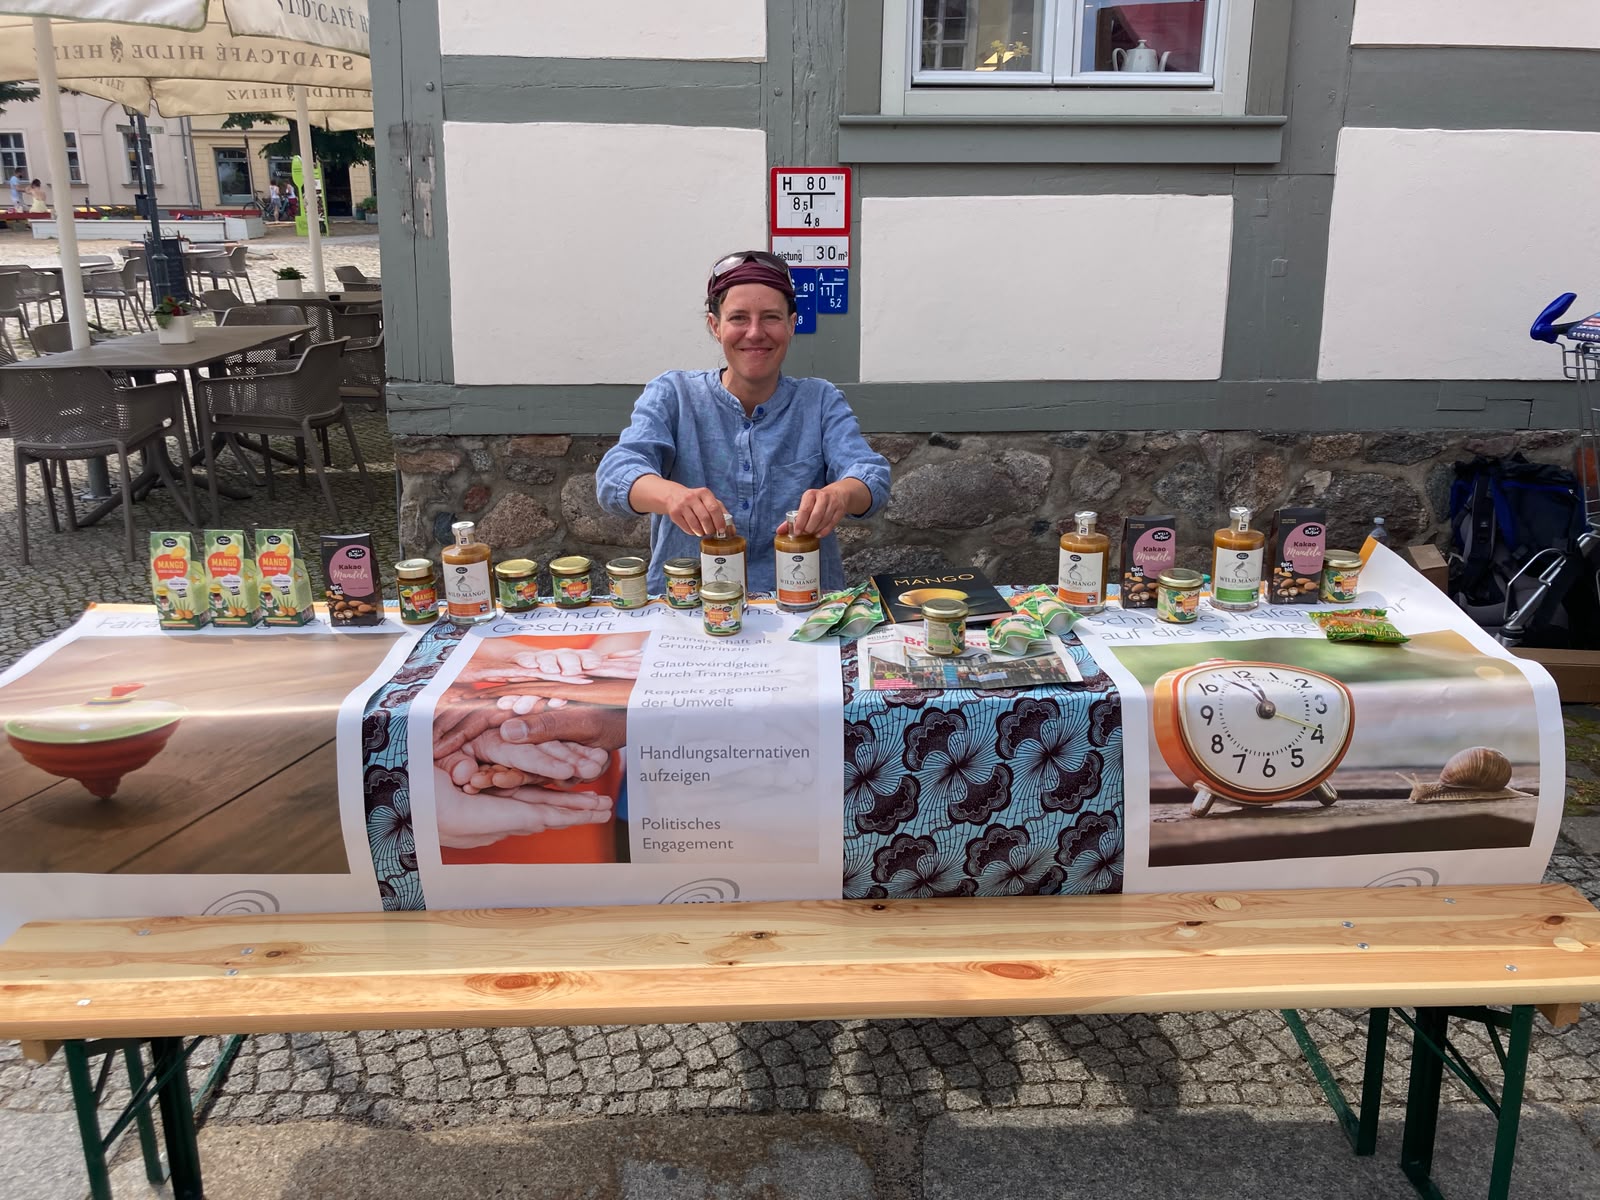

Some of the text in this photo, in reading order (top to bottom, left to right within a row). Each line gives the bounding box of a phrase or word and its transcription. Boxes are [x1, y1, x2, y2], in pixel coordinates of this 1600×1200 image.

[782, 176, 827, 191] H 80
[816, 246, 836, 260] 30
[818, 272, 825, 282] A
[803, 282, 815, 292] 80
[830, 298, 842, 309] 5,2
[1135, 550, 1171, 563] Mandeln
[1285, 546, 1322, 558] Mandeln
[157, 560, 184, 570] MANGO
[211, 558, 238, 568] MANGO
[262, 556, 288, 567] MANGO
[332, 568, 369, 581] Mandeln
[796, 577, 818, 585] MANGO
[894, 573, 975, 586] MANGO
[462, 589, 486, 598] MANGO
[492, 620, 617, 634] Geschäft
[1101, 627, 1140, 640] auf
[1152, 626, 1195, 638] die
[1201, 622, 1320, 638] Sprünge
[660, 634, 773, 646] Partnerschaft als
[658, 642, 751, 653] Grundprinzip
[652, 660, 770, 670] Glaubwürdigkeit
[649, 668, 782, 679] durch Transparenz
[1232, 669, 1255, 680] 12
[1198, 681, 1219, 697] 10
[1294, 678, 1313, 689] 2
[644, 685, 788, 696] Respekt gegenüber
[641, 697, 734, 709] der Umwelt
[1314, 694, 1328, 715] 3
[1199, 704, 1215, 727] 9
[1310, 723, 1325, 745] 4
[1210, 733, 1225, 755] 8
[639, 744, 811, 763] Handlungsalternativen
[1290, 747, 1305, 769] 5
[1232, 753, 1247, 774] 7
[1262, 757, 1277, 778] 6
[639, 768, 711, 785] aufzeigen
[641, 817, 721, 831] Politisches
[642, 837, 735, 853] Engagement
